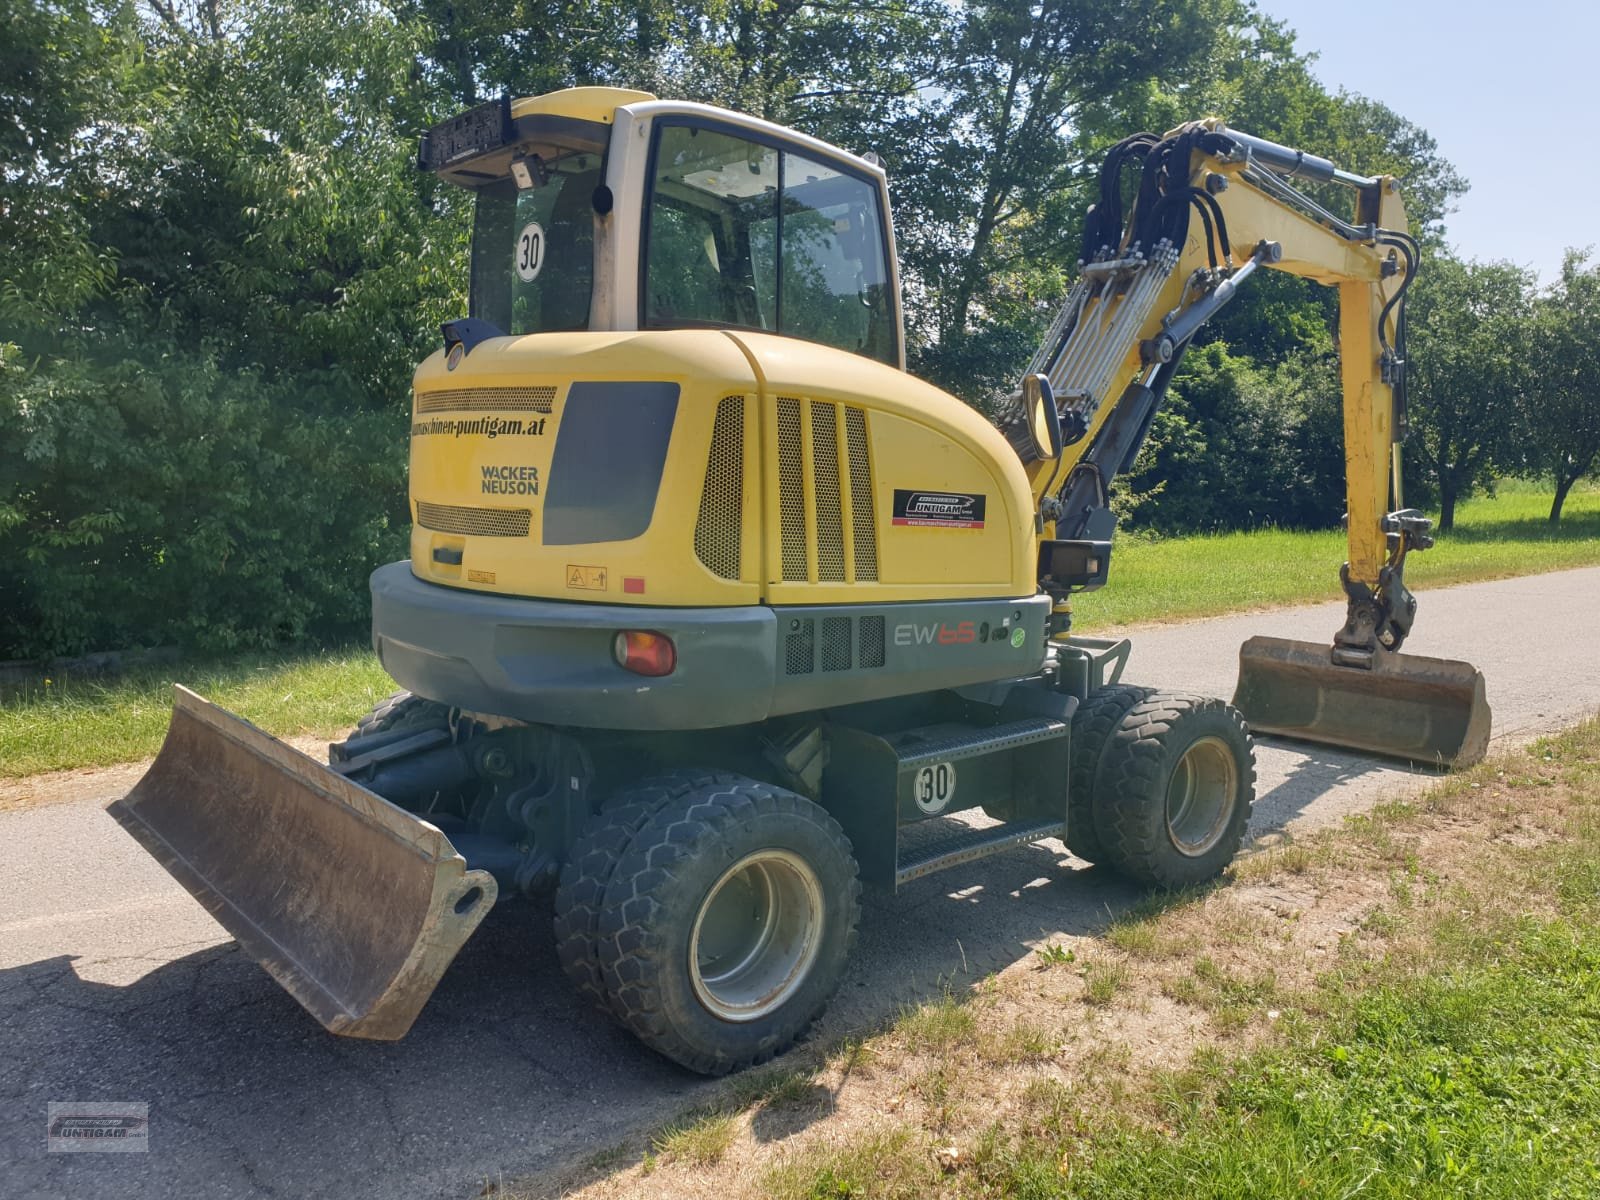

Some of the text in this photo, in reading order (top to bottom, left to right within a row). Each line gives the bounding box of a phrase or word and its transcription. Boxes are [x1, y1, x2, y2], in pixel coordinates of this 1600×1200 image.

[520, 232, 540, 271] 30
[411, 415, 547, 439] maschinen-puntigam.at
[481, 465, 538, 481] WACKER
[481, 480, 539, 495] NEUSON
[893, 621, 977, 645] EW65
[920, 764, 948, 804] 30
